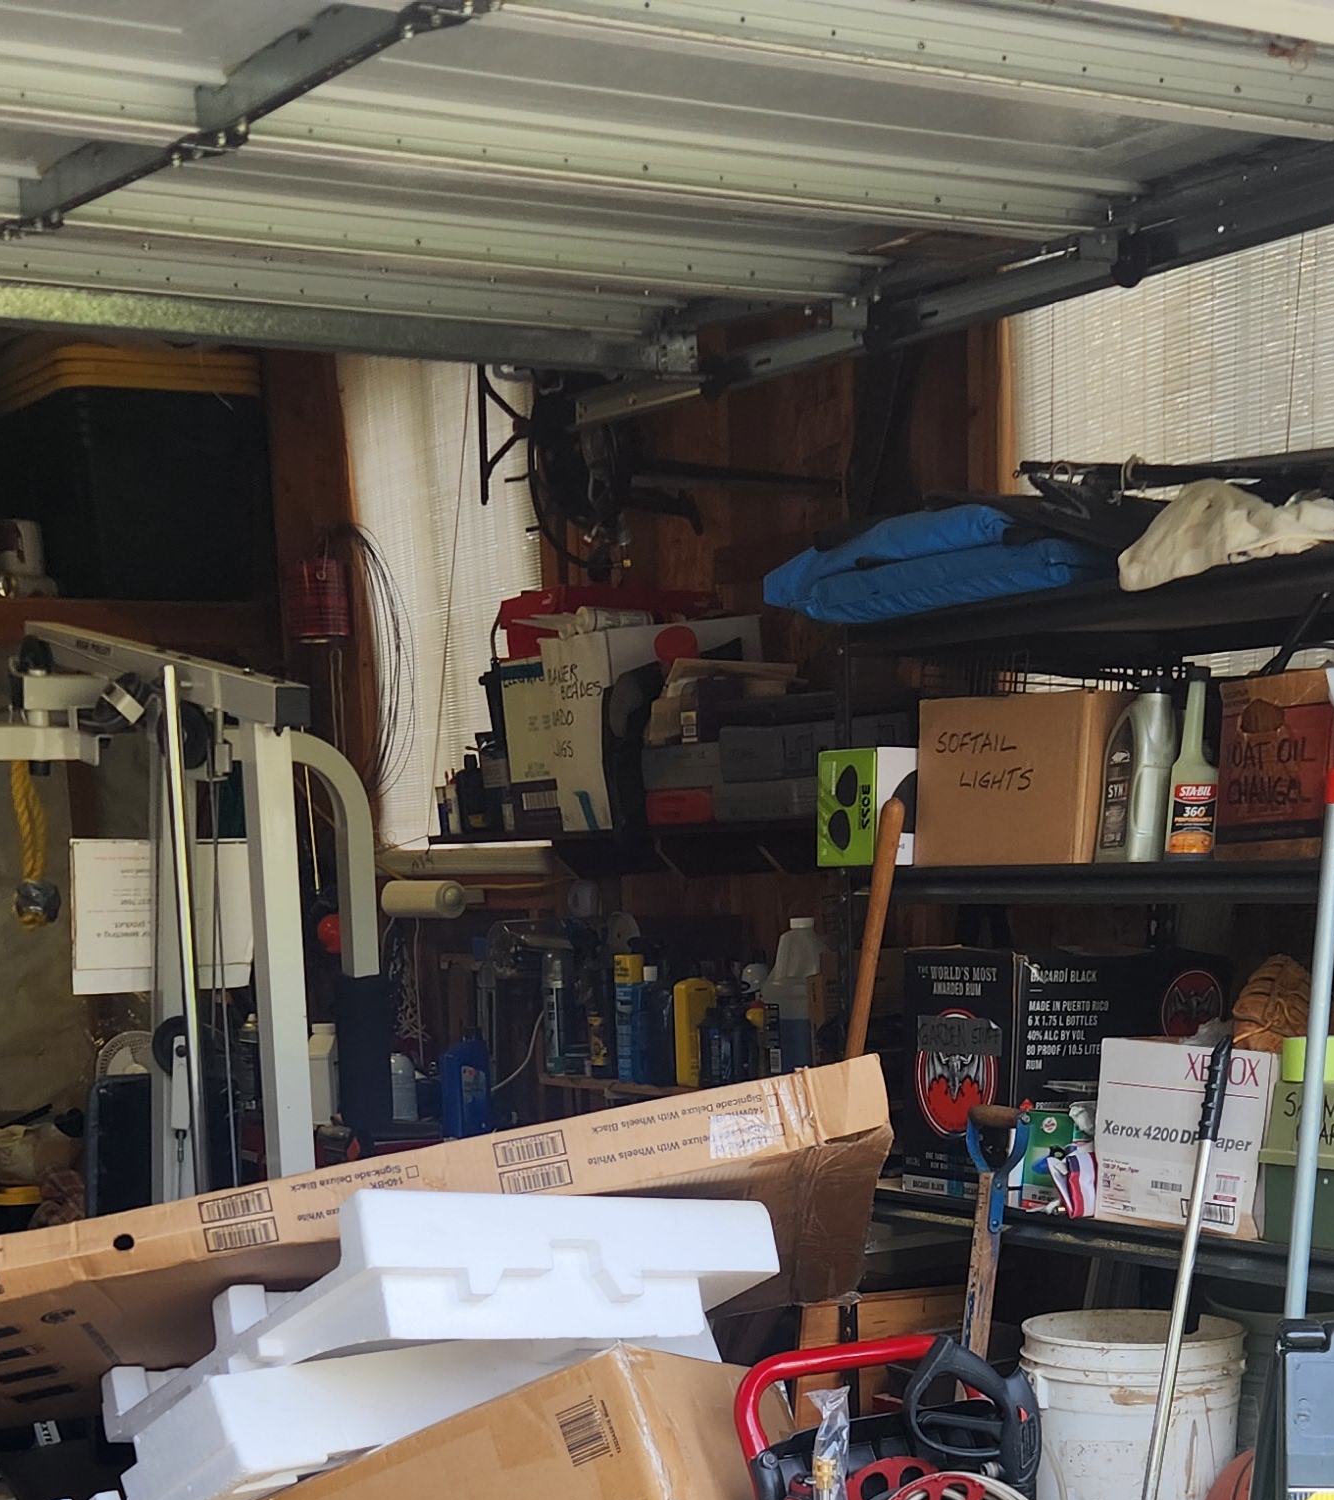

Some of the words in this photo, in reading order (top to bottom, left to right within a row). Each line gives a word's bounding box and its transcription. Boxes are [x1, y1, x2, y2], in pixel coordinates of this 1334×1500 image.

[934, 730, 1018, 755] SOFTAIL
[1276, 736, 1317, 764] OIL
[959, 766, 1035, 792] LIGHTS
[930, 965, 970, 982] WORLD'S
[971, 967, 998, 982] MOST
[1069, 970, 1097, 983] BLACK
[932, 982, 964, 996] AWARDED
[965, 983, 983, 996] RUM
[1028, 1000, 1051, 1013] MADE
[1052, 1001, 1061, 1013] IN
[1061, 1001, 1092, 1012] PUERTO
[1091, 1001, 1110, 1012] RICO
[1027, 1015, 1033, 1027] 6
[1041, 1015, 1058, 1027] 1.75
[1065, 1015, 1099, 1027] BOTTLES
[918, 1020, 968, 1048] GARDEN
[1026, 1029, 1043, 1042] 40%
[1043, 1030, 1060, 1042] ALC
[1060, 1030, 1071, 1041] BY
[1071, 1030, 1086, 1041] VOL
[1025, 1044, 1036, 1056] 80
[1036, 1044, 1061, 1056] PROOF
[1067, 1044, 1083, 1056] 10.5
[1083, 1044, 1101, 1055] LITE
[1025, 1059, 1043, 1071] RUM
[1184, 1052, 1261, 1087] XEOX
[716, 1094, 764, 1111] Signicade
[656, 1109, 681, 1122] With
[681, 1103, 715, 1117] Deluxe
[620, 1113, 657, 1128] Wheels
[591, 1122, 620, 1135] Black
[1102, 1119, 1142, 1139] Xerox
[1143, 1125, 1179, 1144] 4200
[1214, 1136, 1253, 1153] aper
[618, 1143, 657, 1161] Wheels
[656, 1138, 681, 1152] With
[586, 1153, 618, 1167] White
[290, 1180, 318, 1192] Black
[297, 1211, 326, 1223] White
